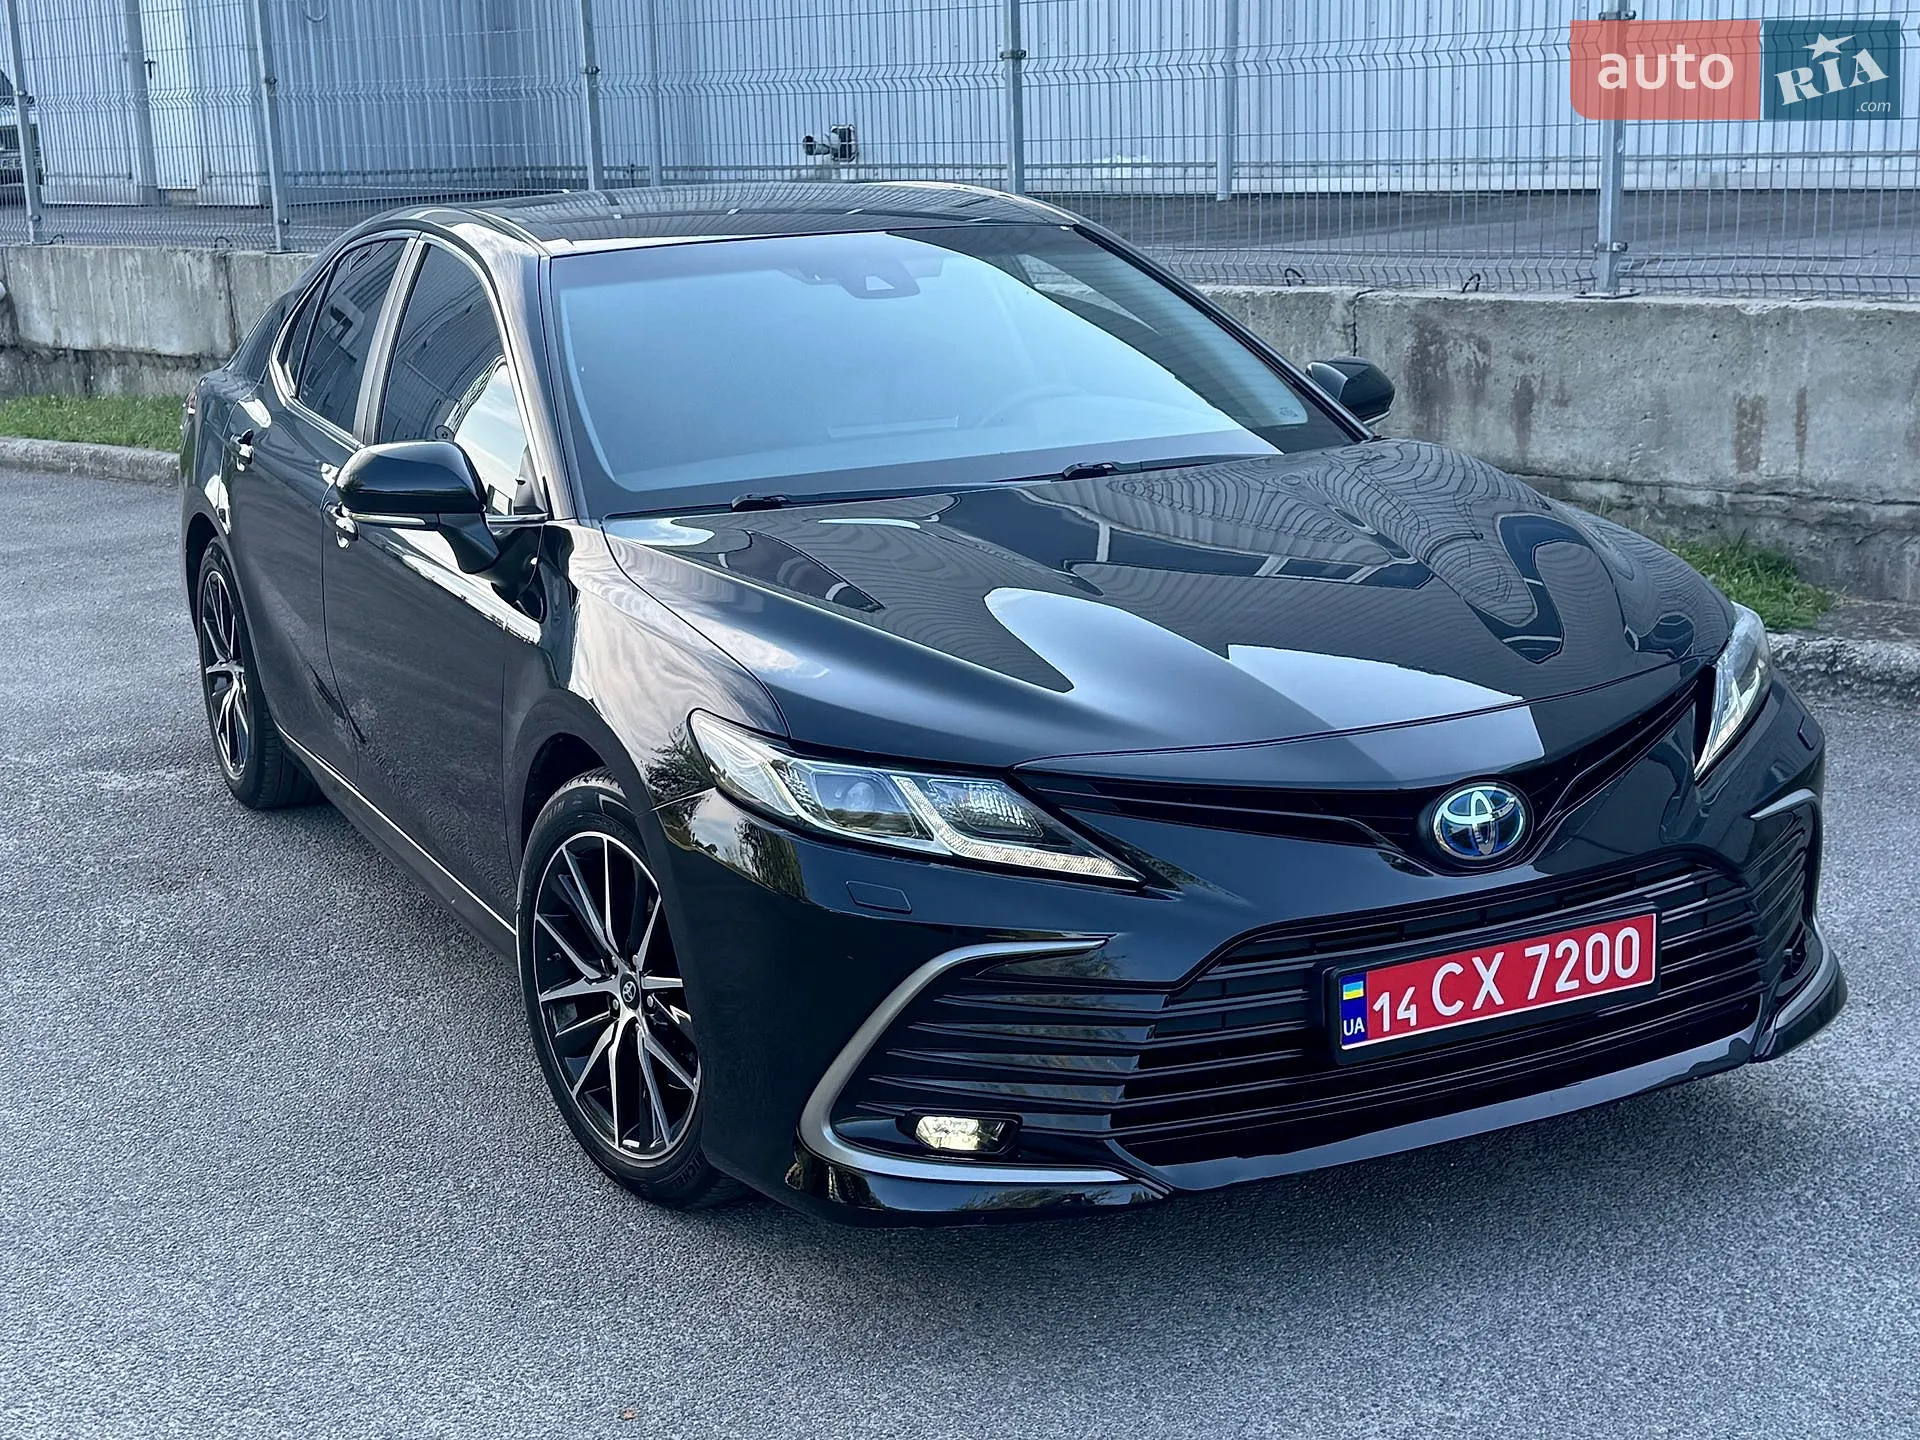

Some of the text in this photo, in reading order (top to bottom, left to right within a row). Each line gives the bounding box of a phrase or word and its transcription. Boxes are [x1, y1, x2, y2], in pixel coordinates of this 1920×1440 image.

[1373, 926, 1640, 1032] 14 CX 7200
[1343, 1017, 1365, 1036] UA
